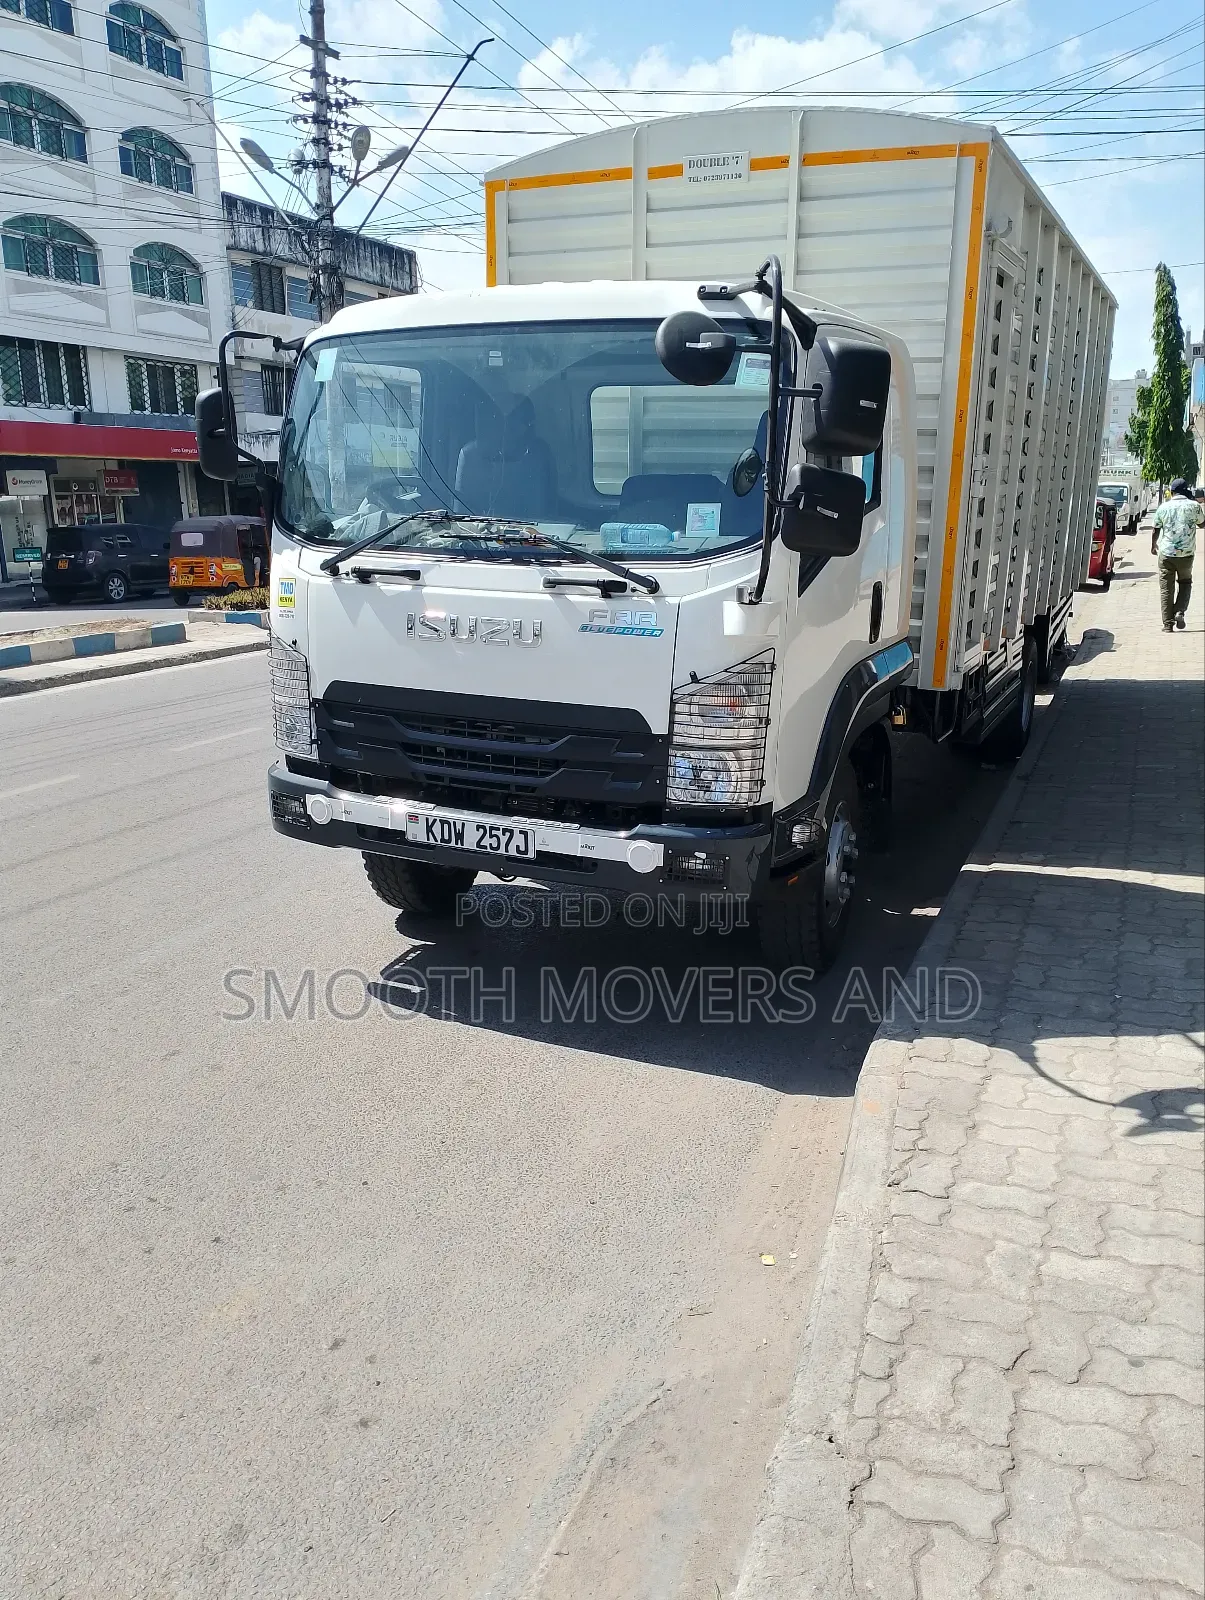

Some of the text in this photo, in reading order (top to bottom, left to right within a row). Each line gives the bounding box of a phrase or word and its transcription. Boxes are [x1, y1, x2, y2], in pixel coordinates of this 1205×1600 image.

[688, 156, 729, 169] DOUBLE
[105, 476, 119, 484] DTB
[589, 609, 657, 626] FRR
[407, 612, 543, 648] ISUZU
[425, 817, 530, 857] KDW 257J
